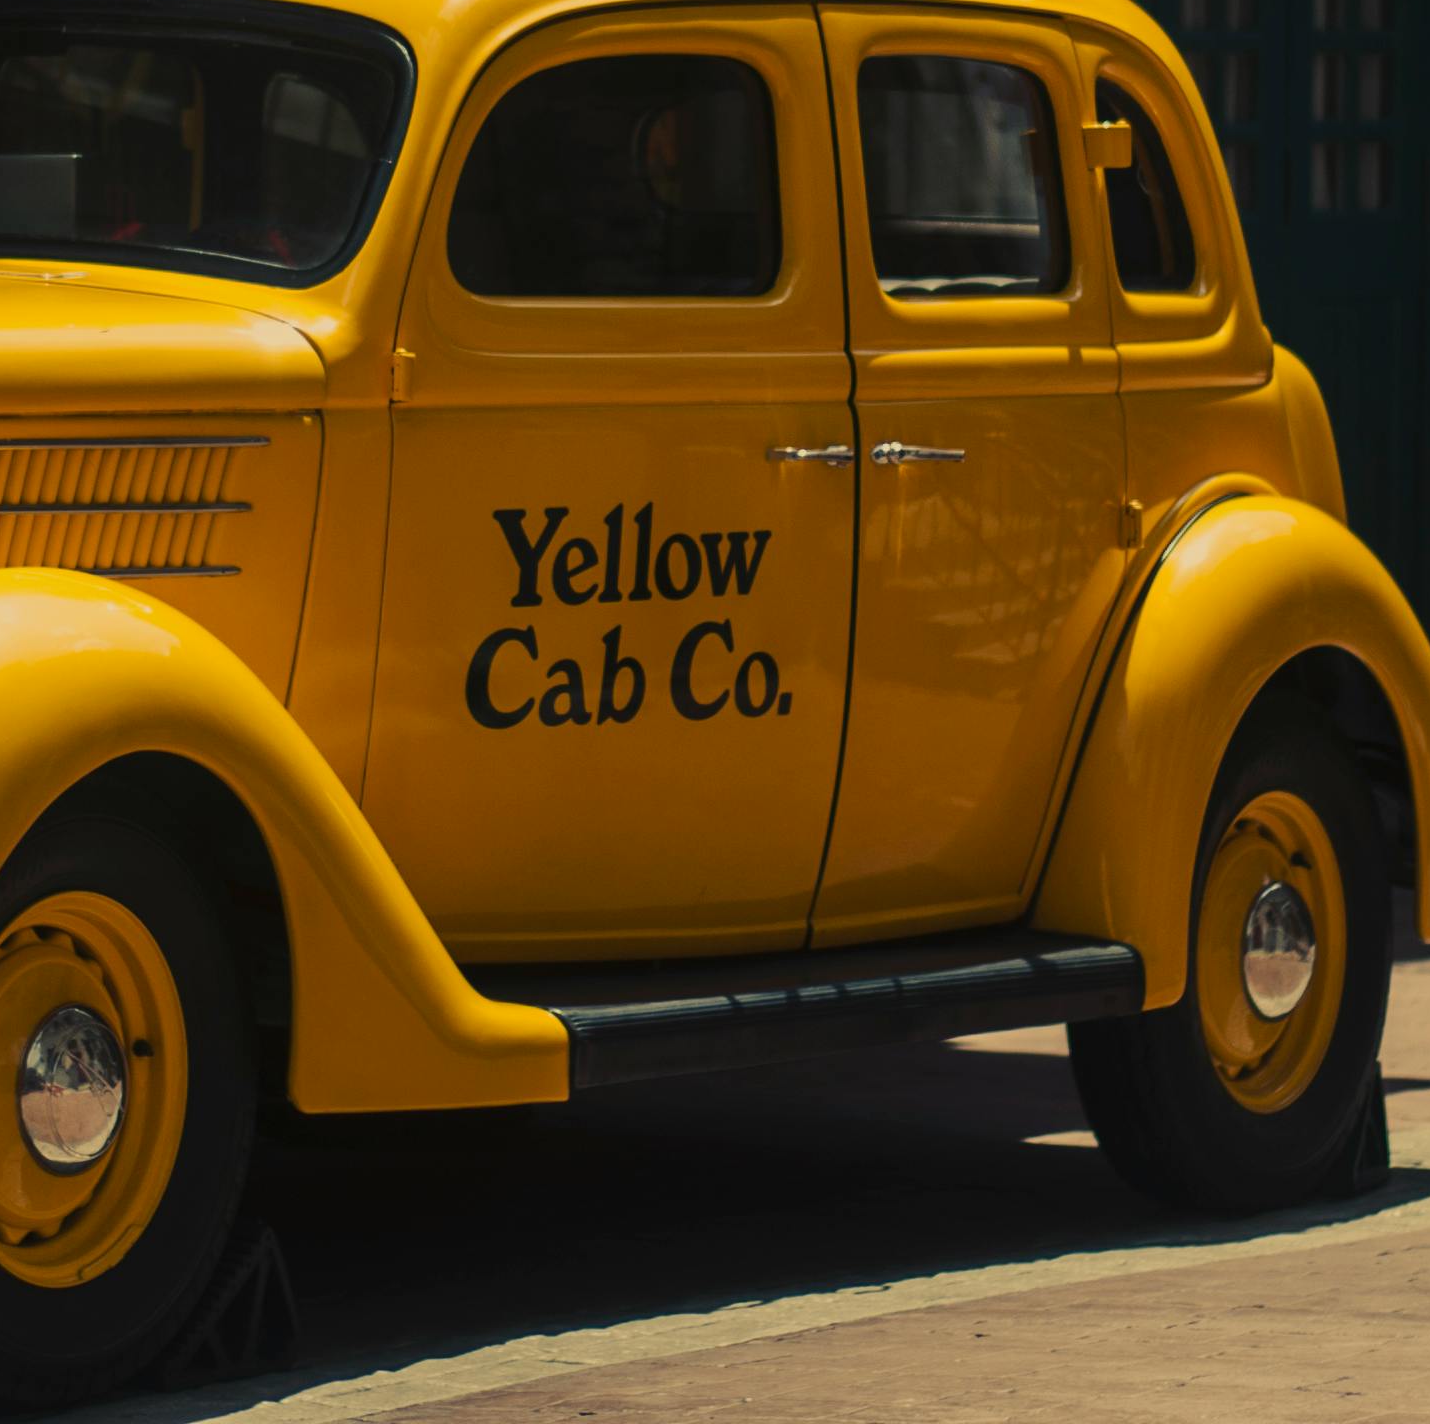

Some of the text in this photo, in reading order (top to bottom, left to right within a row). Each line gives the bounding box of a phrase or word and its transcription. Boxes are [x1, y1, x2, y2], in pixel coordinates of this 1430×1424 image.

[492, 501, 772, 608] Yellow
[465, 618, 793, 729] Cab Co.
